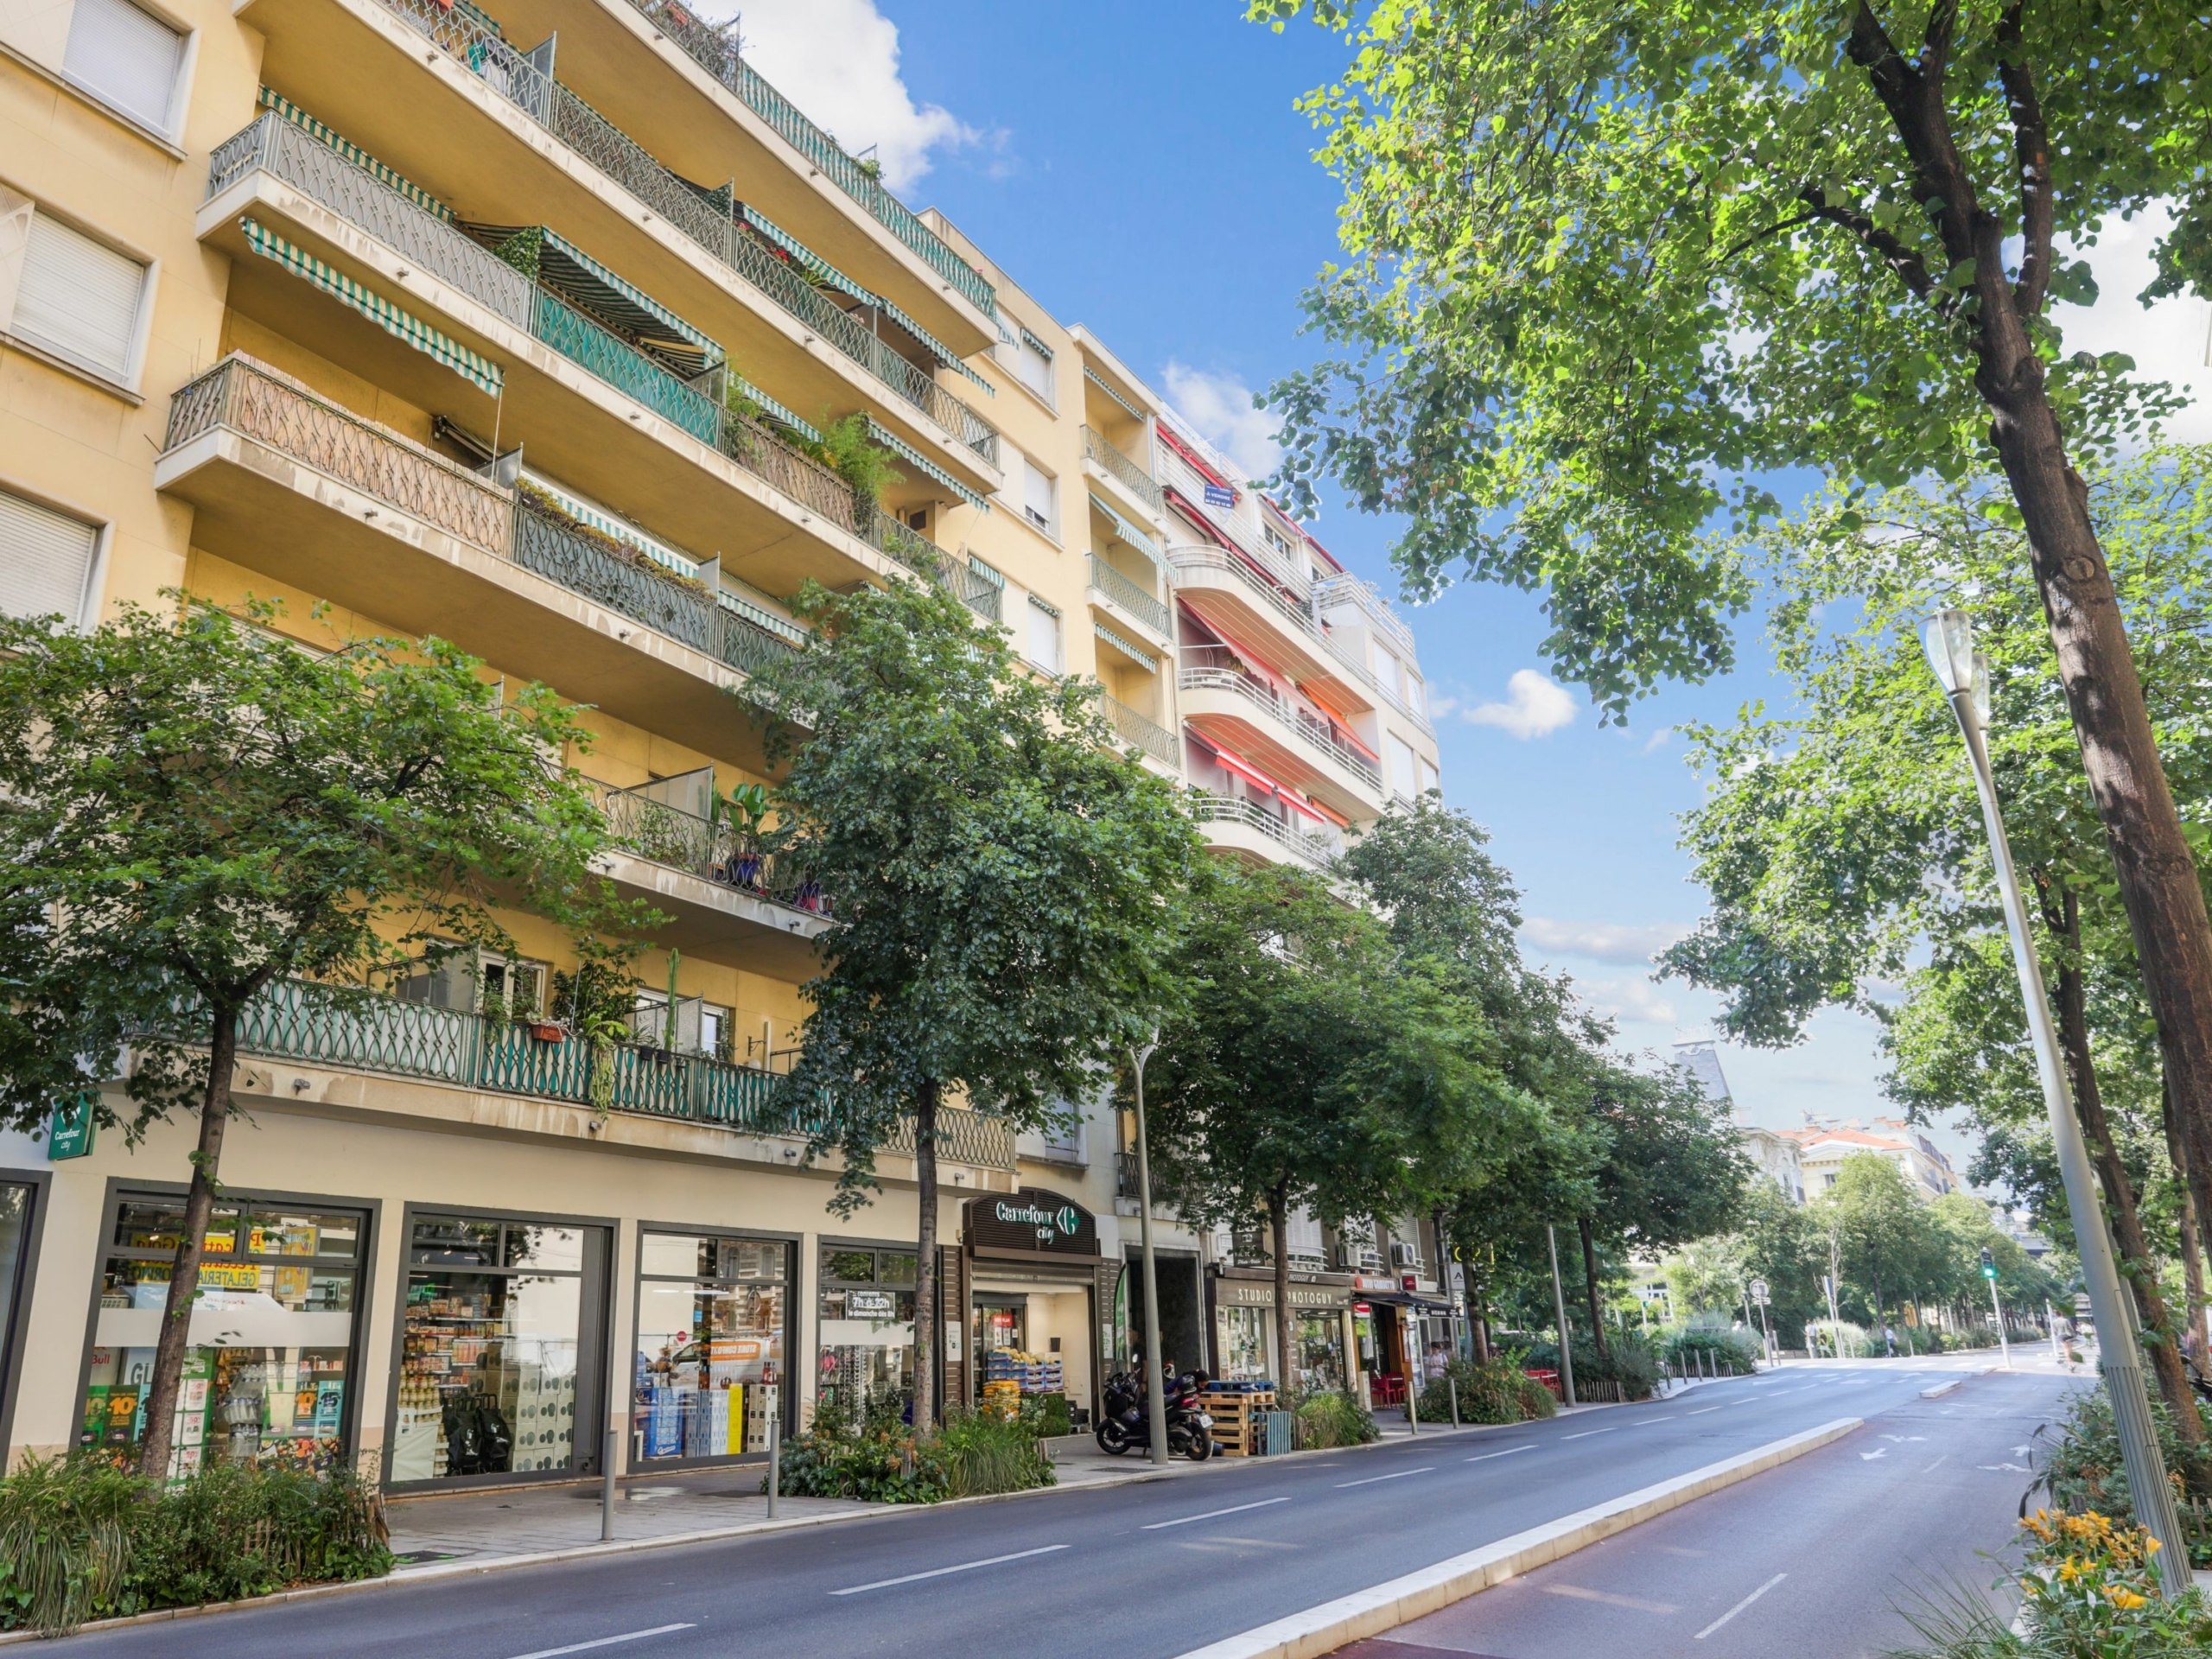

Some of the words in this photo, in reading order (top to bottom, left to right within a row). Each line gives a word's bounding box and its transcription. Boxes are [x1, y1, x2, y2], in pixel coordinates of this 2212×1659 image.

[54, 1128, 80, 1141] Carrefour
[60, 1141, 71, 1151] city
[995, 1201, 1054, 1225] Carrefour
[1037, 1226, 1055, 1244] city
[1238, 1288, 1272, 1302] STUDIO
[1287, 1291, 1332, 1305] PHOTOGUY
[92, 1354, 110, 1364] Bull
